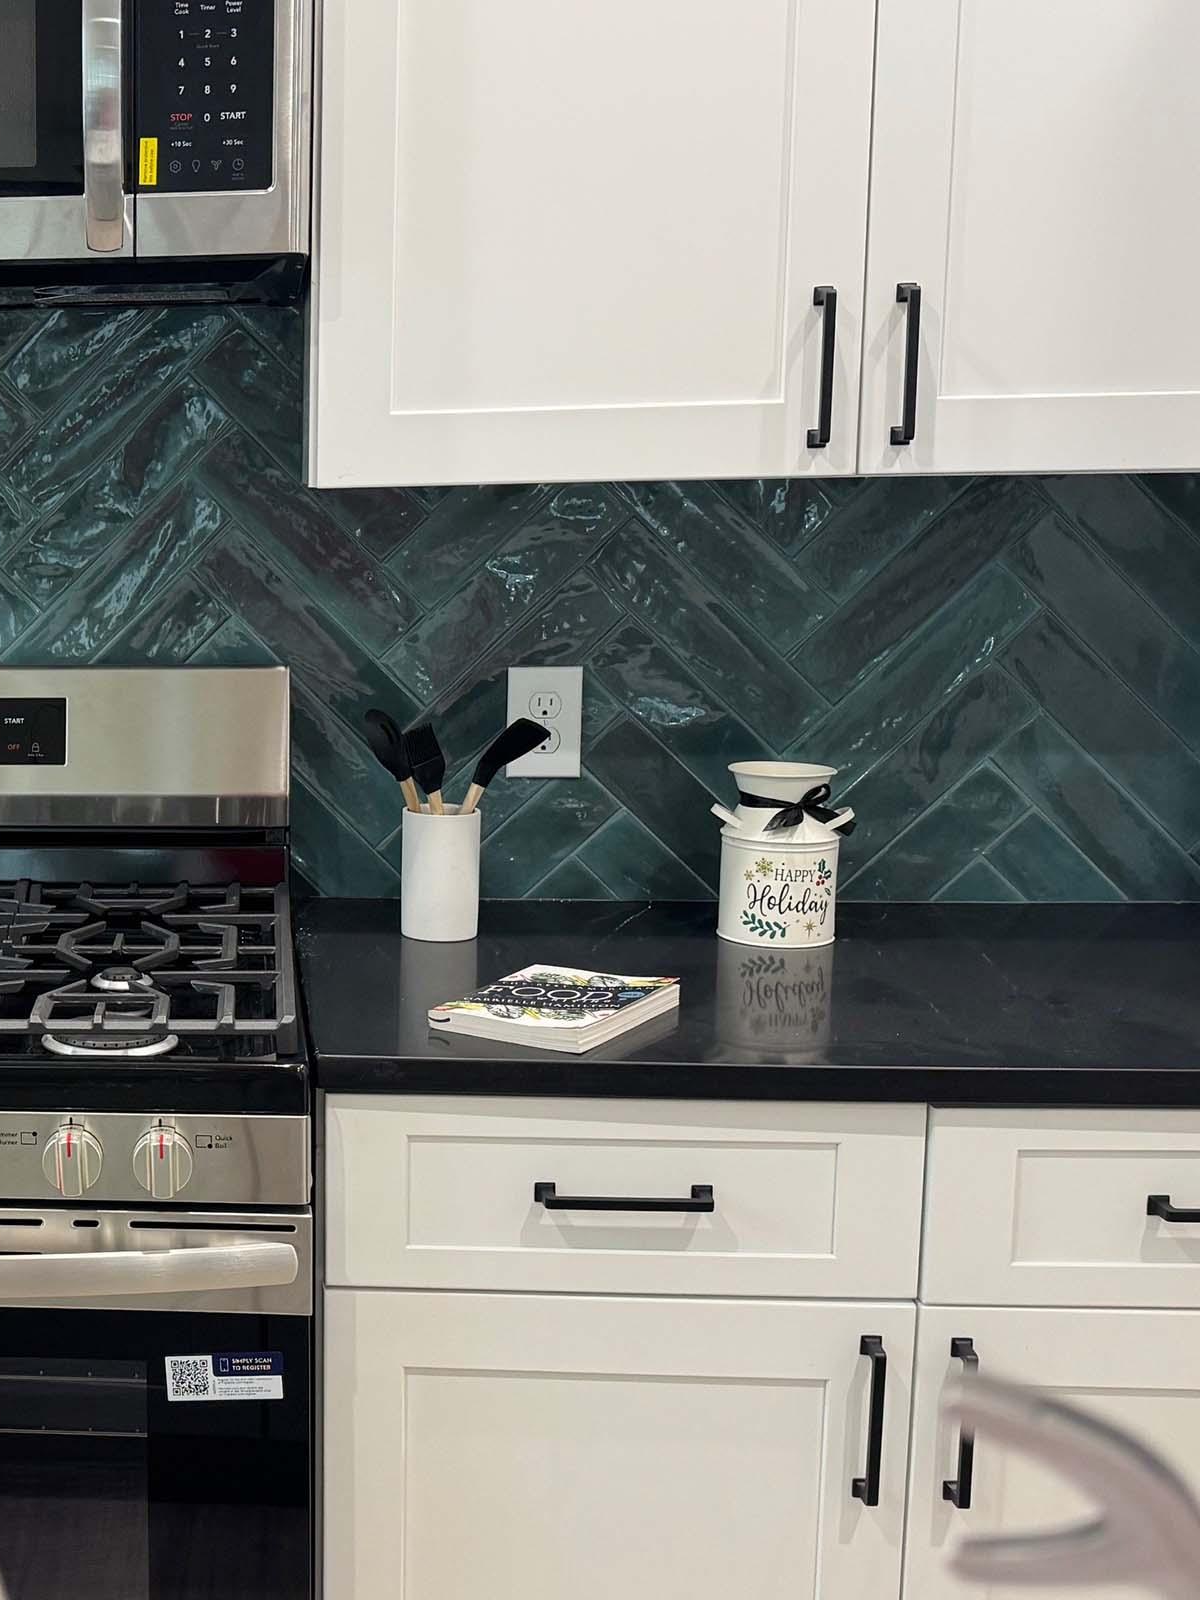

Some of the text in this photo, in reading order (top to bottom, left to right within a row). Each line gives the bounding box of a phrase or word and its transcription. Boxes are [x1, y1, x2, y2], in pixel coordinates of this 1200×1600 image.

[179, 28, 237, 39] 1 2 3
[178, 56, 237, 67] 4 5 6
[178, 84, 237, 95] 7 8 9
[170, 113, 192, 121] STOP
[204, 112, 211, 122] 0
[220, 111, 246, 120] START
[774, 868, 816, 882] HAPPY
[747, 883, 828, 925] Holiday
[478, 985, 613, 1001] FOOD
